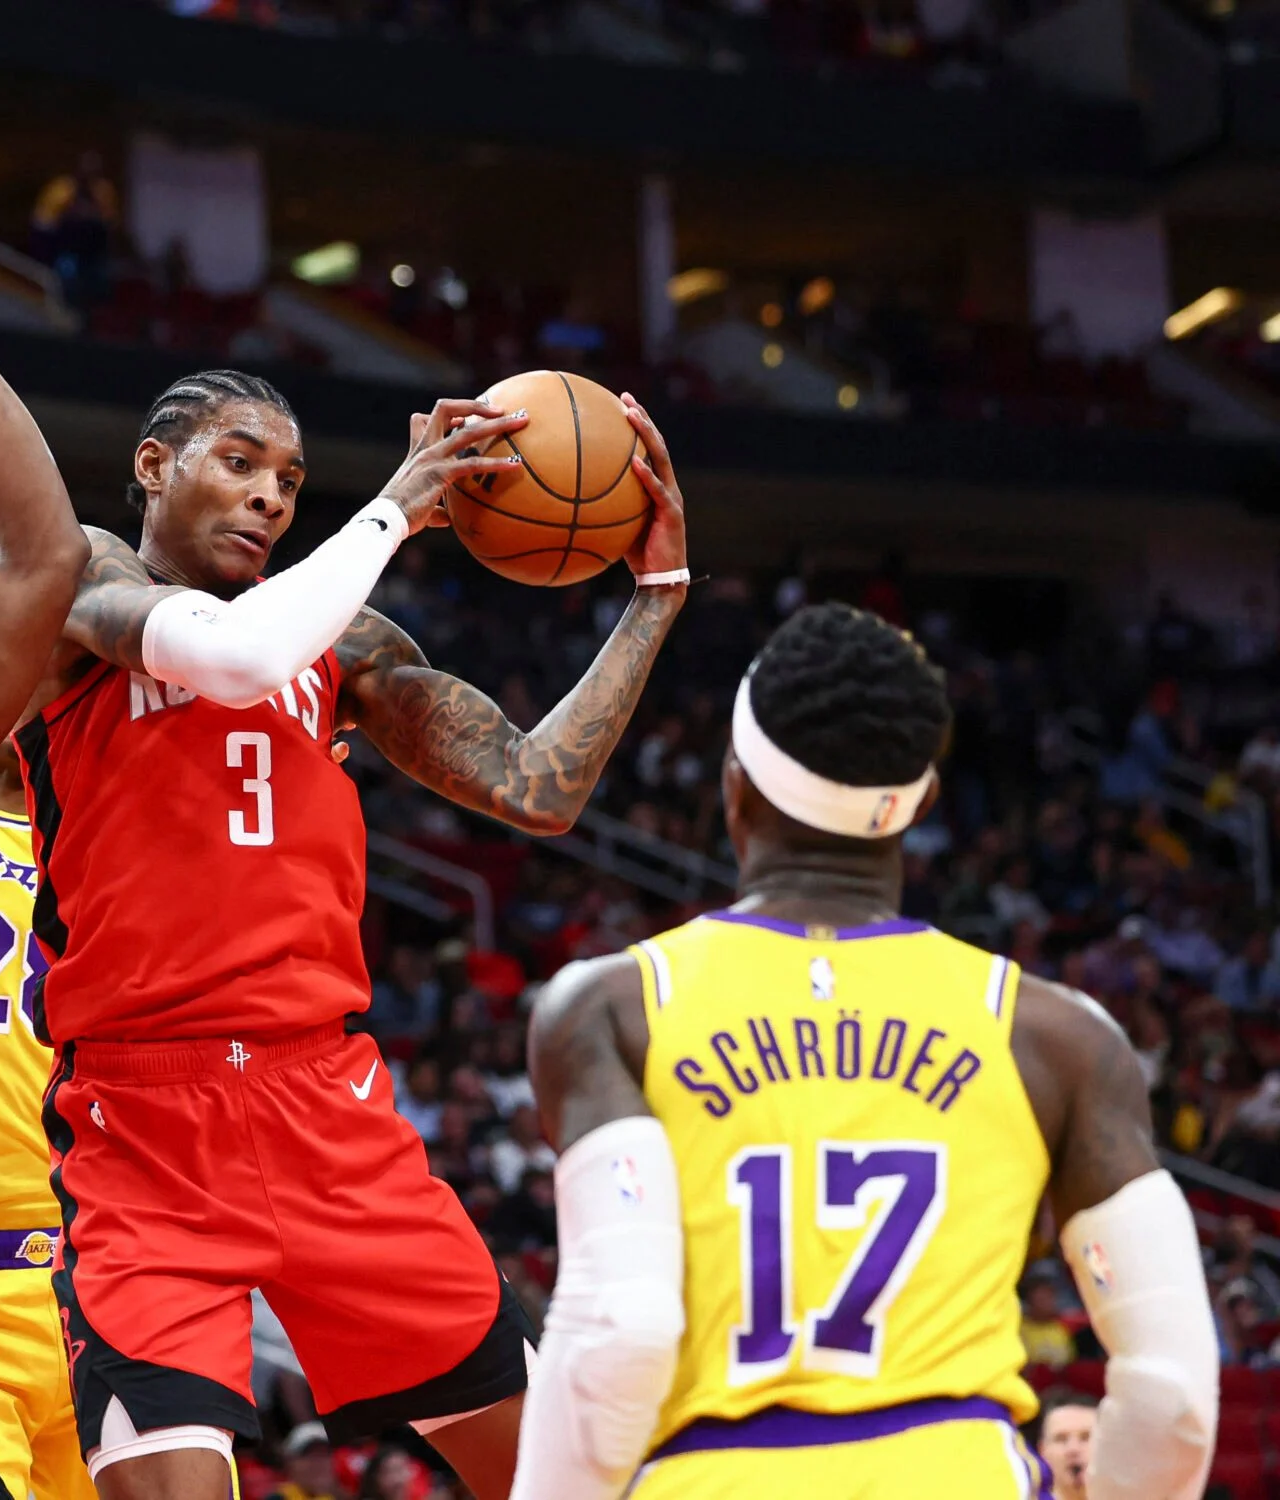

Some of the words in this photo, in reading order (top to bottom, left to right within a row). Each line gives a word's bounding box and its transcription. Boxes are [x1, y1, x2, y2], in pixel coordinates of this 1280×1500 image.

[225, 731, 274, 846] 3
[674, 1008, 982, 1118] SCHRÖDER
[727, 1139, 947, 1386] 17
